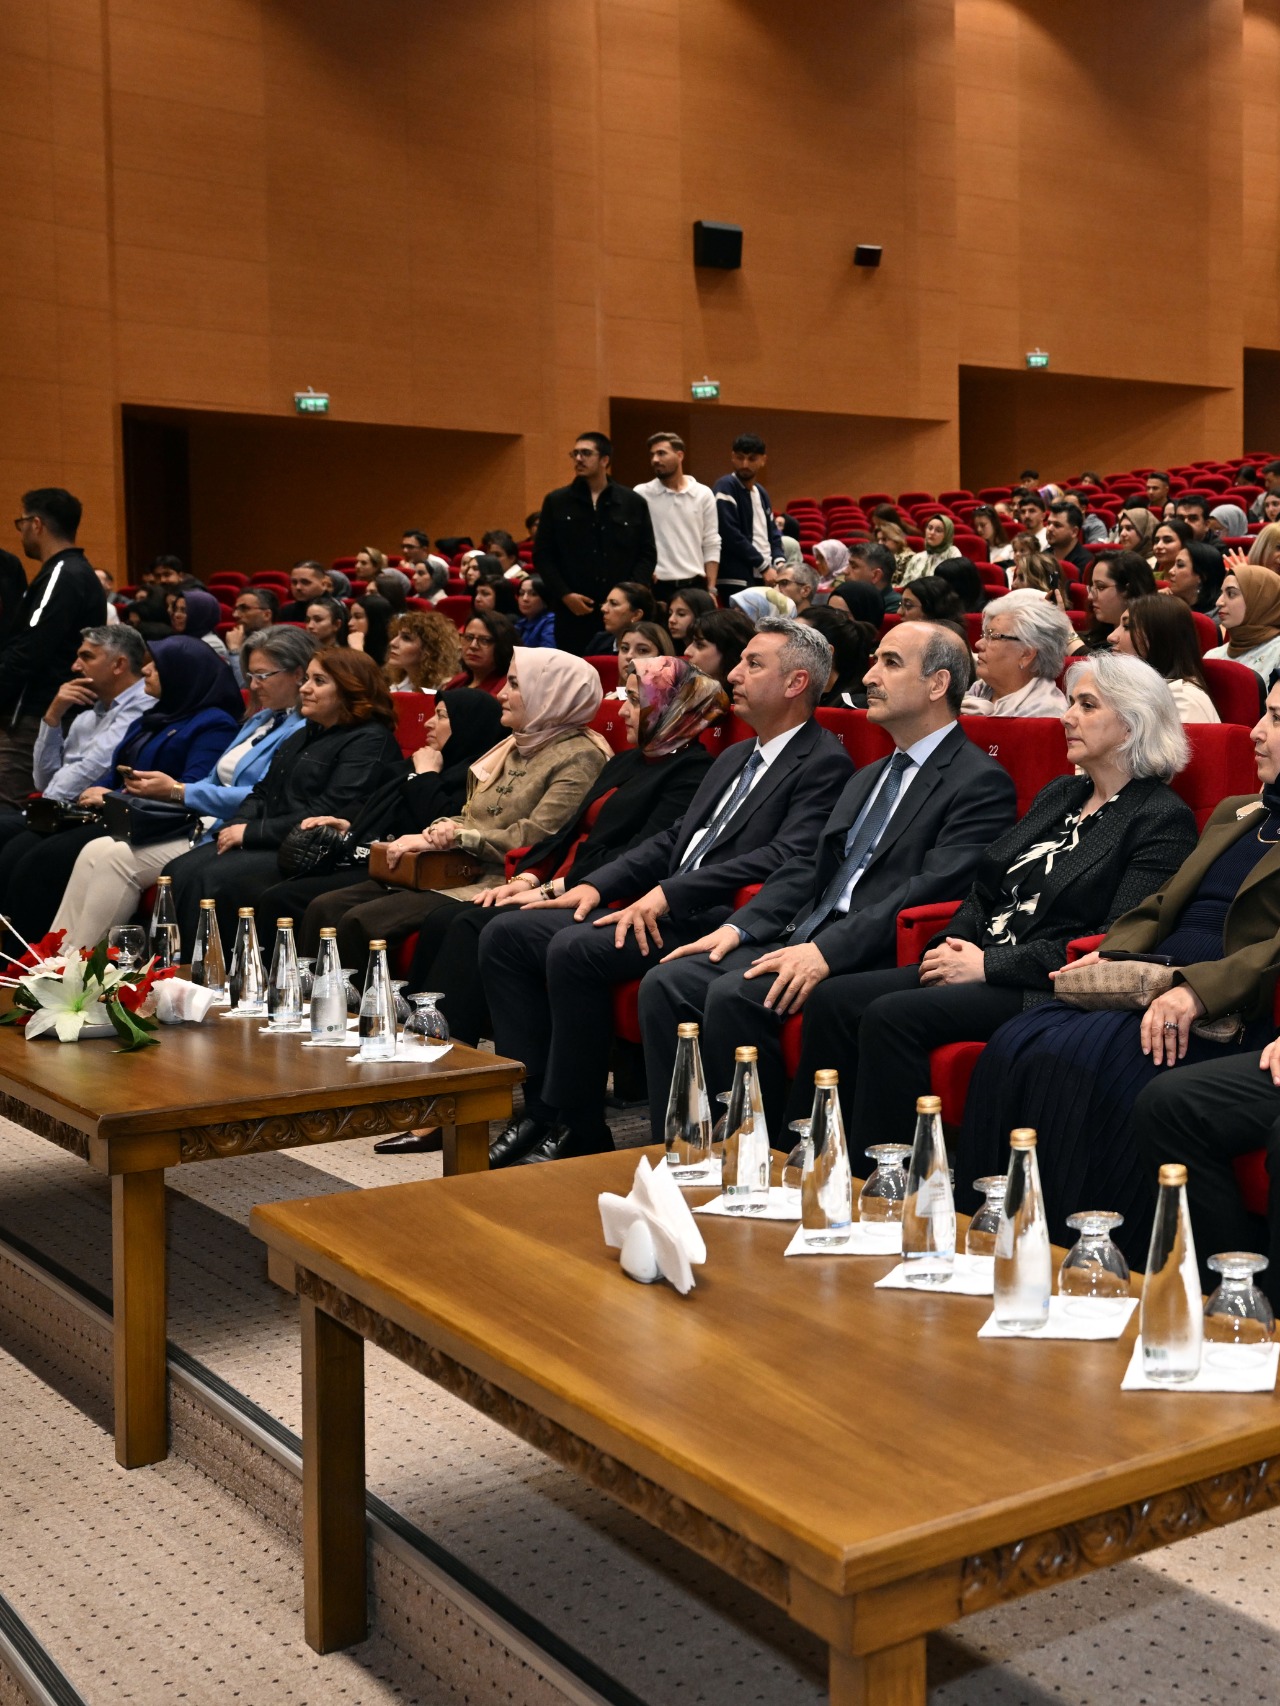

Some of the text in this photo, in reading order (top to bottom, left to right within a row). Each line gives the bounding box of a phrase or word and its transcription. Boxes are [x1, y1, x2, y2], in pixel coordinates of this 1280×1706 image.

[606, 721, 613, 731] 19
[713, 726, 722, 738] 20
[988, 744, 999, 757] 22
